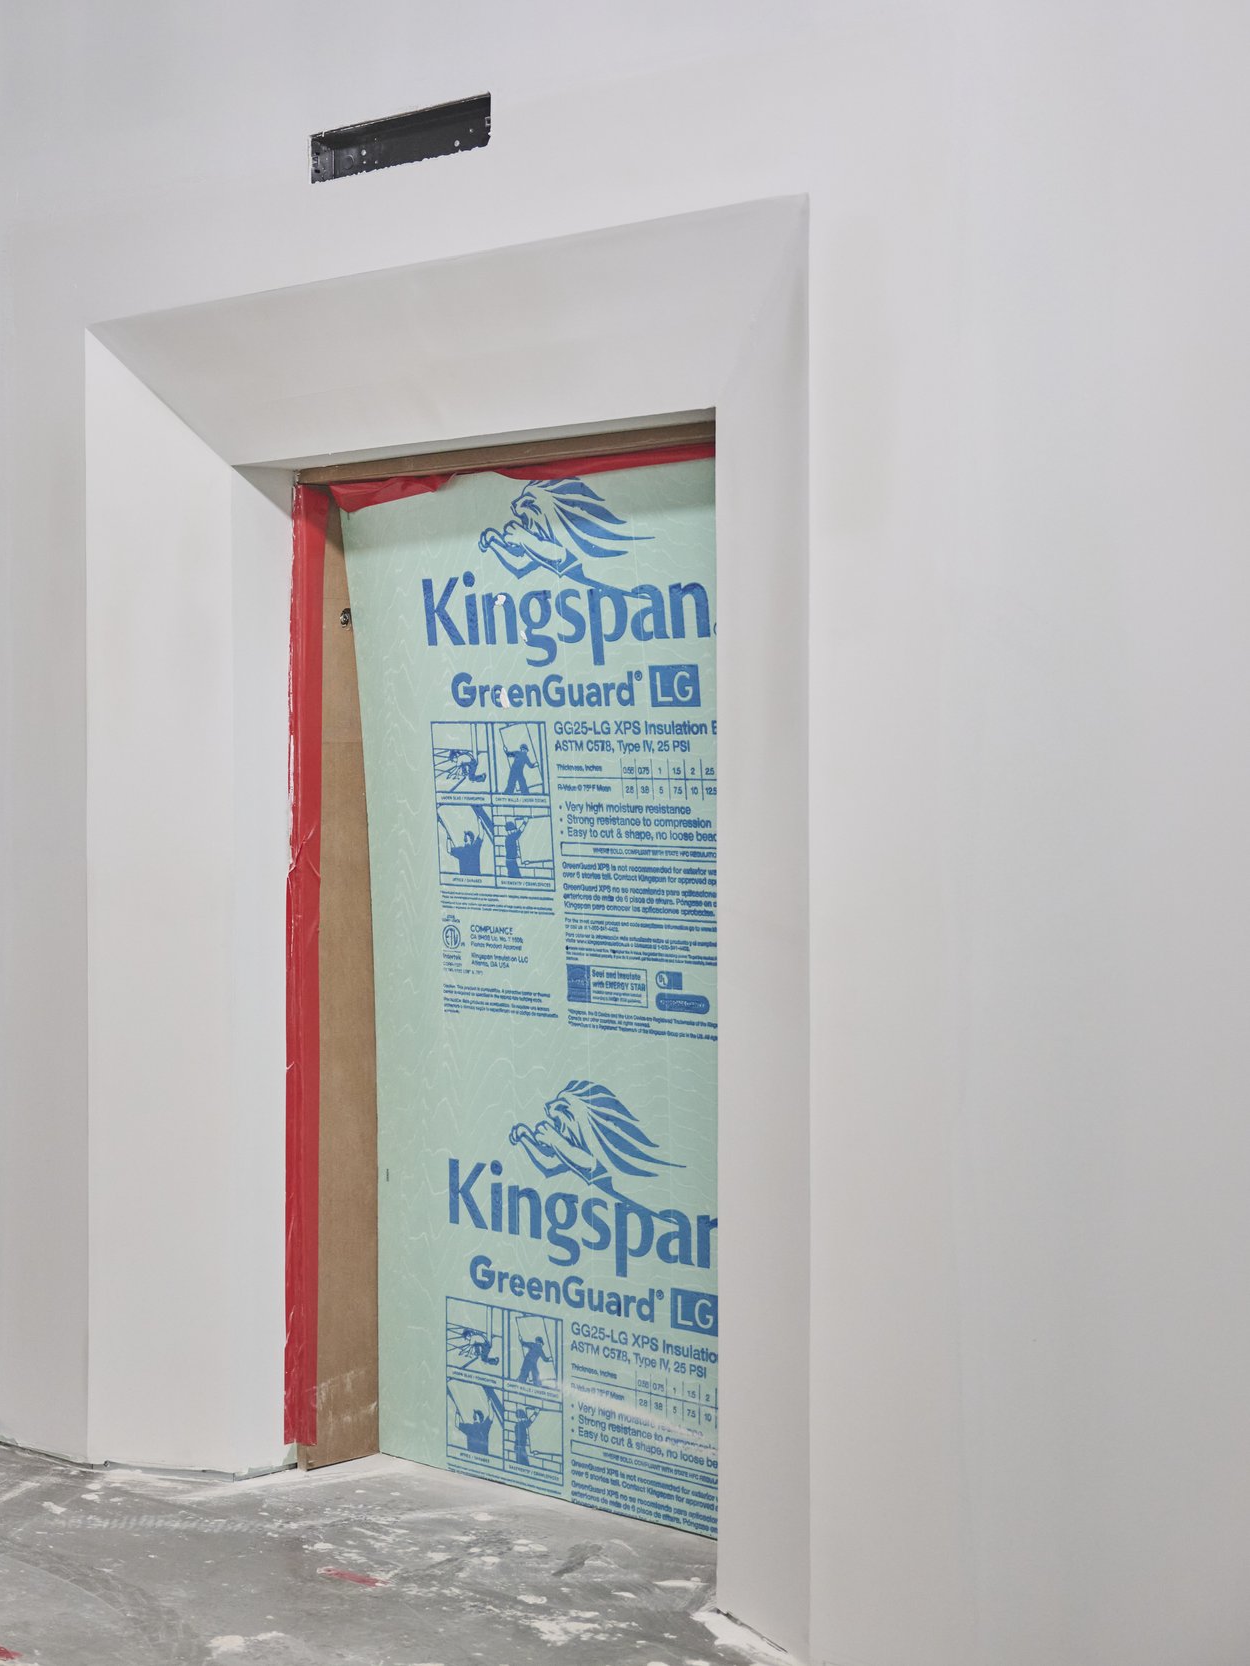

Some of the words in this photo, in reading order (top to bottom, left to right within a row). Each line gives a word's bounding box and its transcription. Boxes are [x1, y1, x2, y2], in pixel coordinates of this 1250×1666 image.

[655, 671, 693, 703] LG
[553, 720, 611, 735] GG25-LG
[614, 720, 641, 735] XPS
[644, 720, 707, 735] Insulation
[554, 740, 583, 751] ASTM
[616, 740, 640, 754] Type
[642, 740, 654, 753] IV,
[657, 740, 670, 752] 25
[672, 740, 690, 752] PSI
[691, 767, 696, 775] 2
[660, 786, 664, 794] 5
[691, 787, 698, 795] 10
[565, 801, 583, 813] Very
[586, 802, 604, 814] high
[606, 803, 644, 814] moisture
[645, 804, 691, 815] resistance
[567, 814, 594, 827] Strong
[596, 815, 640, 827] resistance
[642, 818, 651, 826] to
[654, 817, 712, 830] compression
[567, 827, 586, 839] Easy
[589, 828, 598, 838] to
[600, 829, 614, 838] cut
[616, 829, 622, 838] &
[625, 829, 654, 842] shape,
[656, 831, 667, 840] no
[670, 830, 694, 841] loose
[617, 864, 628, 872] not
[673, 867, 681, 875] for
[613, 873, 638, 882] Contact
[677, 1295, 714, 1329] LG
[571, 1321, 628, 1346] GG25-LG
[631, 1333, 659, 1352] XPS
[663, 1339, 718, 1364] Insulatio
[571, 1340, 599, 1356] ASTM
[633, 1352, 656, 1370] Type
[660, 1358, 670, 1372] IV,
[673, 1361, 686, 1375] 25
[690, 1364, 706, 1379] PSI
[706, 1394, 710, 1402] 2
[578, 1402, 596, 1416] Very
[598, 1407, 615, 1421] high
[578, 1414, 606, 1432] Strong
[608, 1421, 652, 1440] resistance
[654, 1432, 663, 1442] to
[578, 1427, 598, 1442] Easy
[600, 1433, 609, 1444] to
[611, 1435, 625, 1447] cut
[627, 1438, 633, 1449] &
[666, 1448, 677, 1459] no
[680, 1450, 704, 1466] loose
